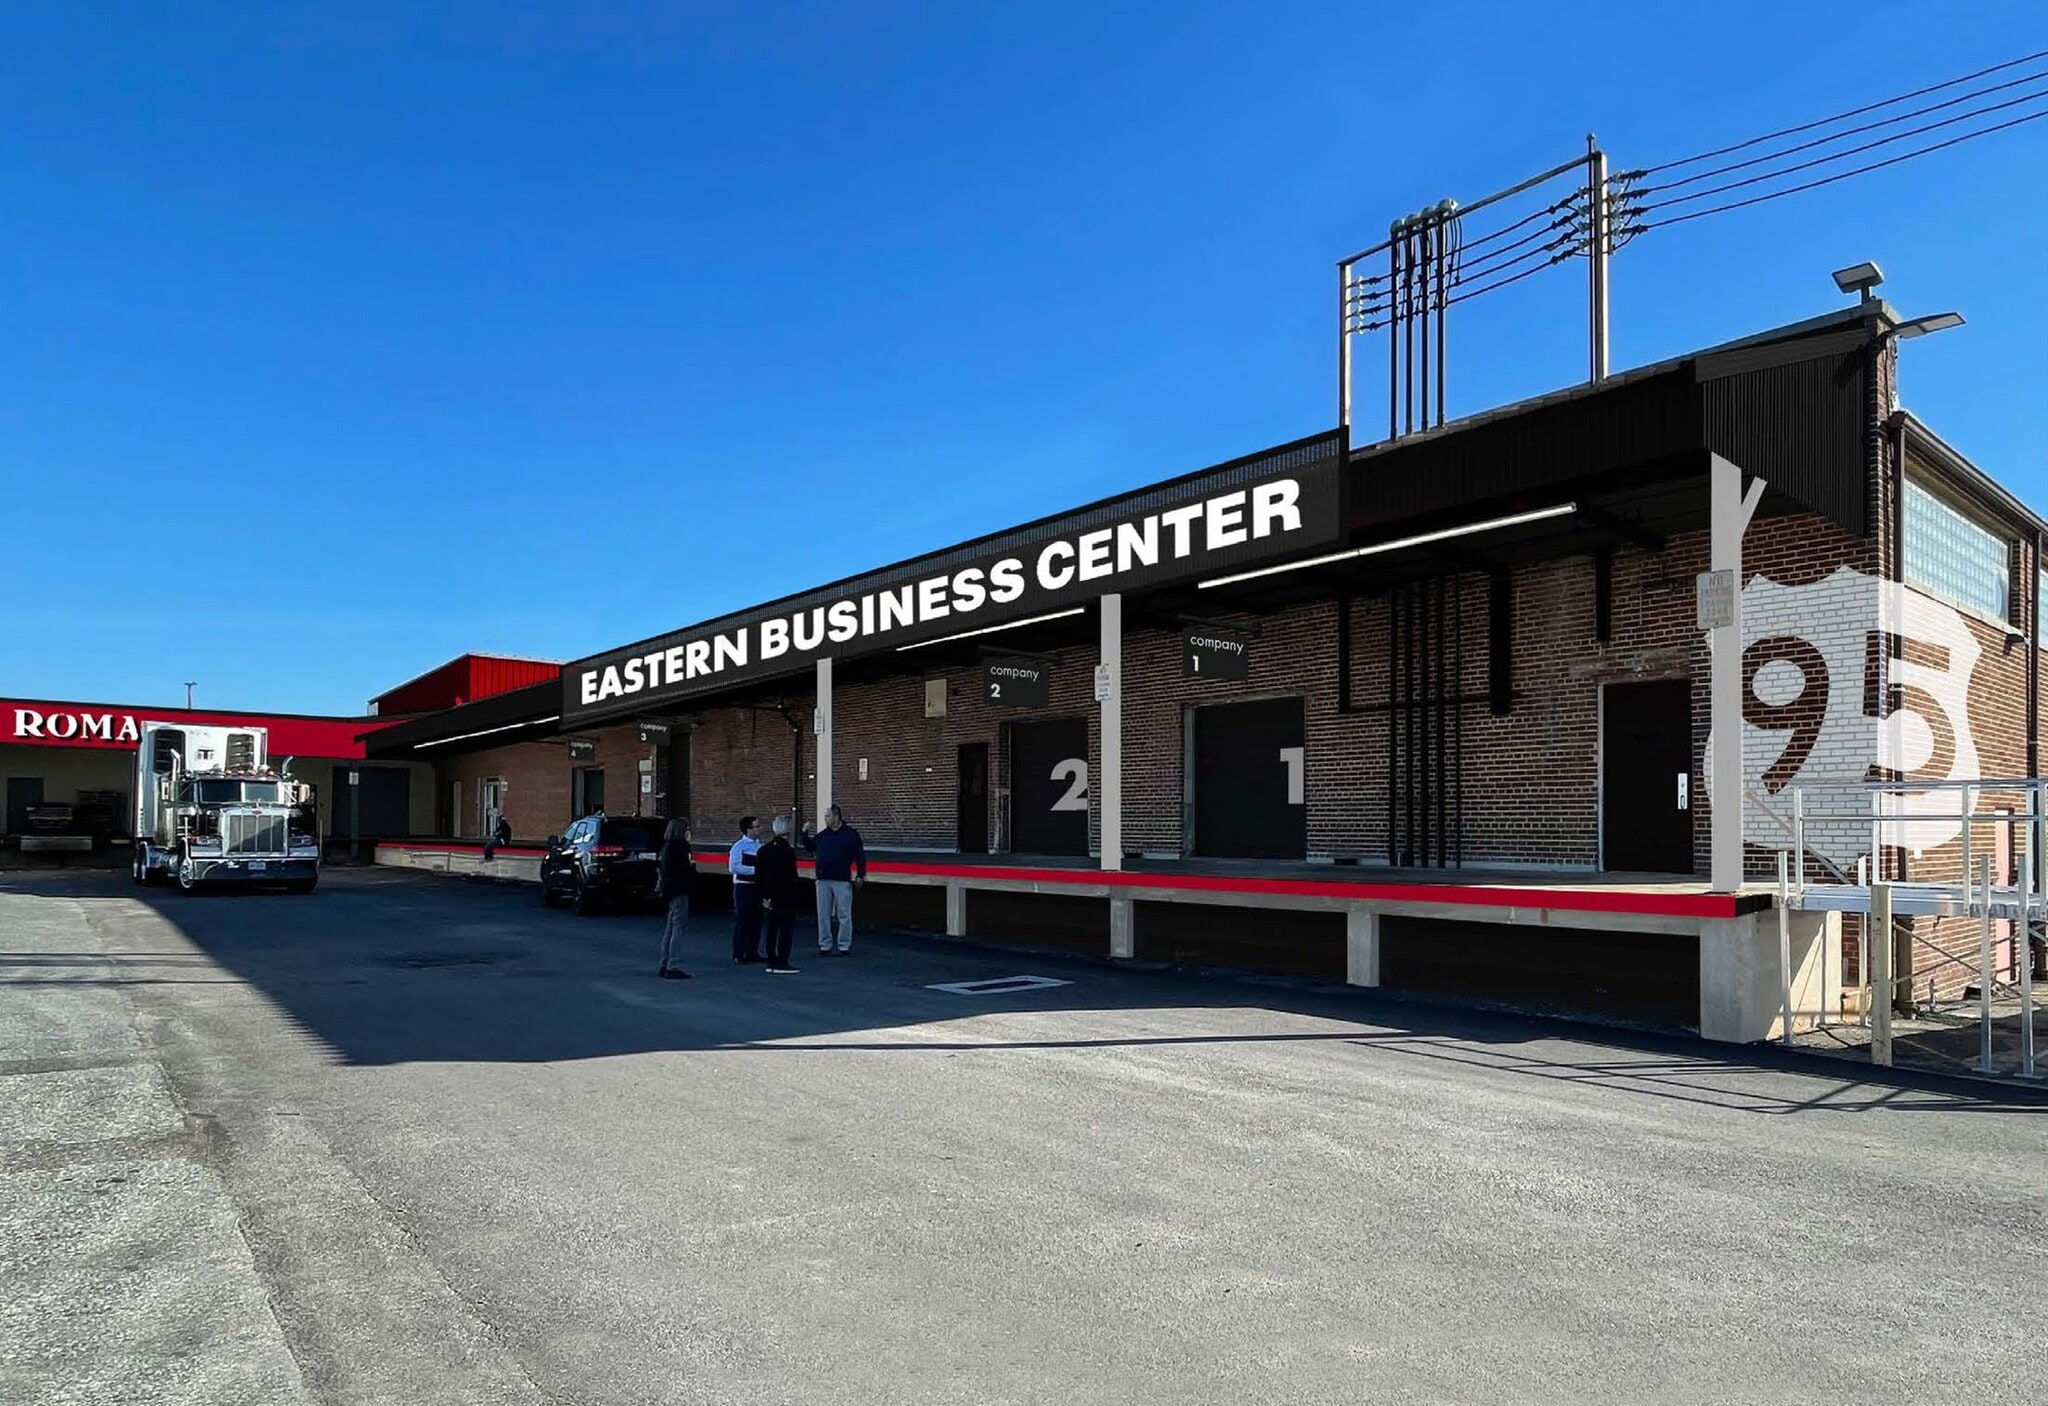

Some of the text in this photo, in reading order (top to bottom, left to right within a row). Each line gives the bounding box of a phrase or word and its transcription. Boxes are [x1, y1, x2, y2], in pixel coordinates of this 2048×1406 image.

[581, 479, 1302, 705] EASTERN BUSINESS CENTER
[1190, 636, 1244, 655] company
[1192, 655, 1200, 672] 1
[990, 666, 1039, 682] company
[990, 683, 1001, 698] 2
[1741, 630, 1956, 798] 95
[13, 709, 139, 741] ROMA
[640, 723, 668, 732] company
[640, 732, 647, 741] 3
[1050, 758, 1088, 811] 2
[1279, 747, 1304, 805] 1
